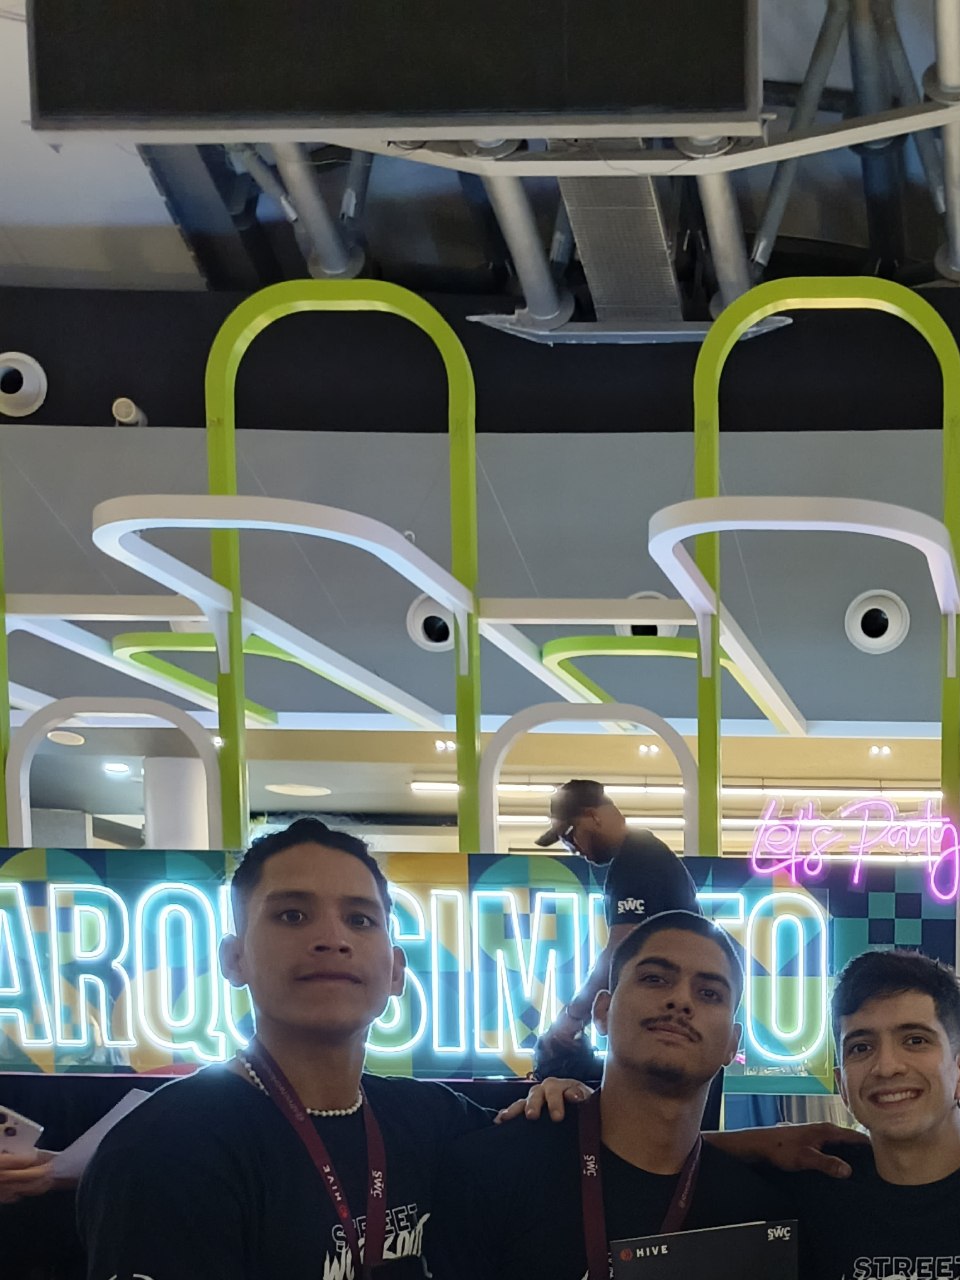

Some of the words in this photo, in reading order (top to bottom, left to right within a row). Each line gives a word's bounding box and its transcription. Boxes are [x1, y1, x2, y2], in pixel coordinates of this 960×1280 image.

[752, 799, 842, 883] Let's
[617, 897, 645, 914] SWC
[583, 1154, 599, 1177] SWC
[322, 1164, 342, 1201] HIVE
[371, 1170, 383, 1199] SWC
[767, 1226, 791, 1242] SWC
[636, 1245, 669, 1258] HIVE
